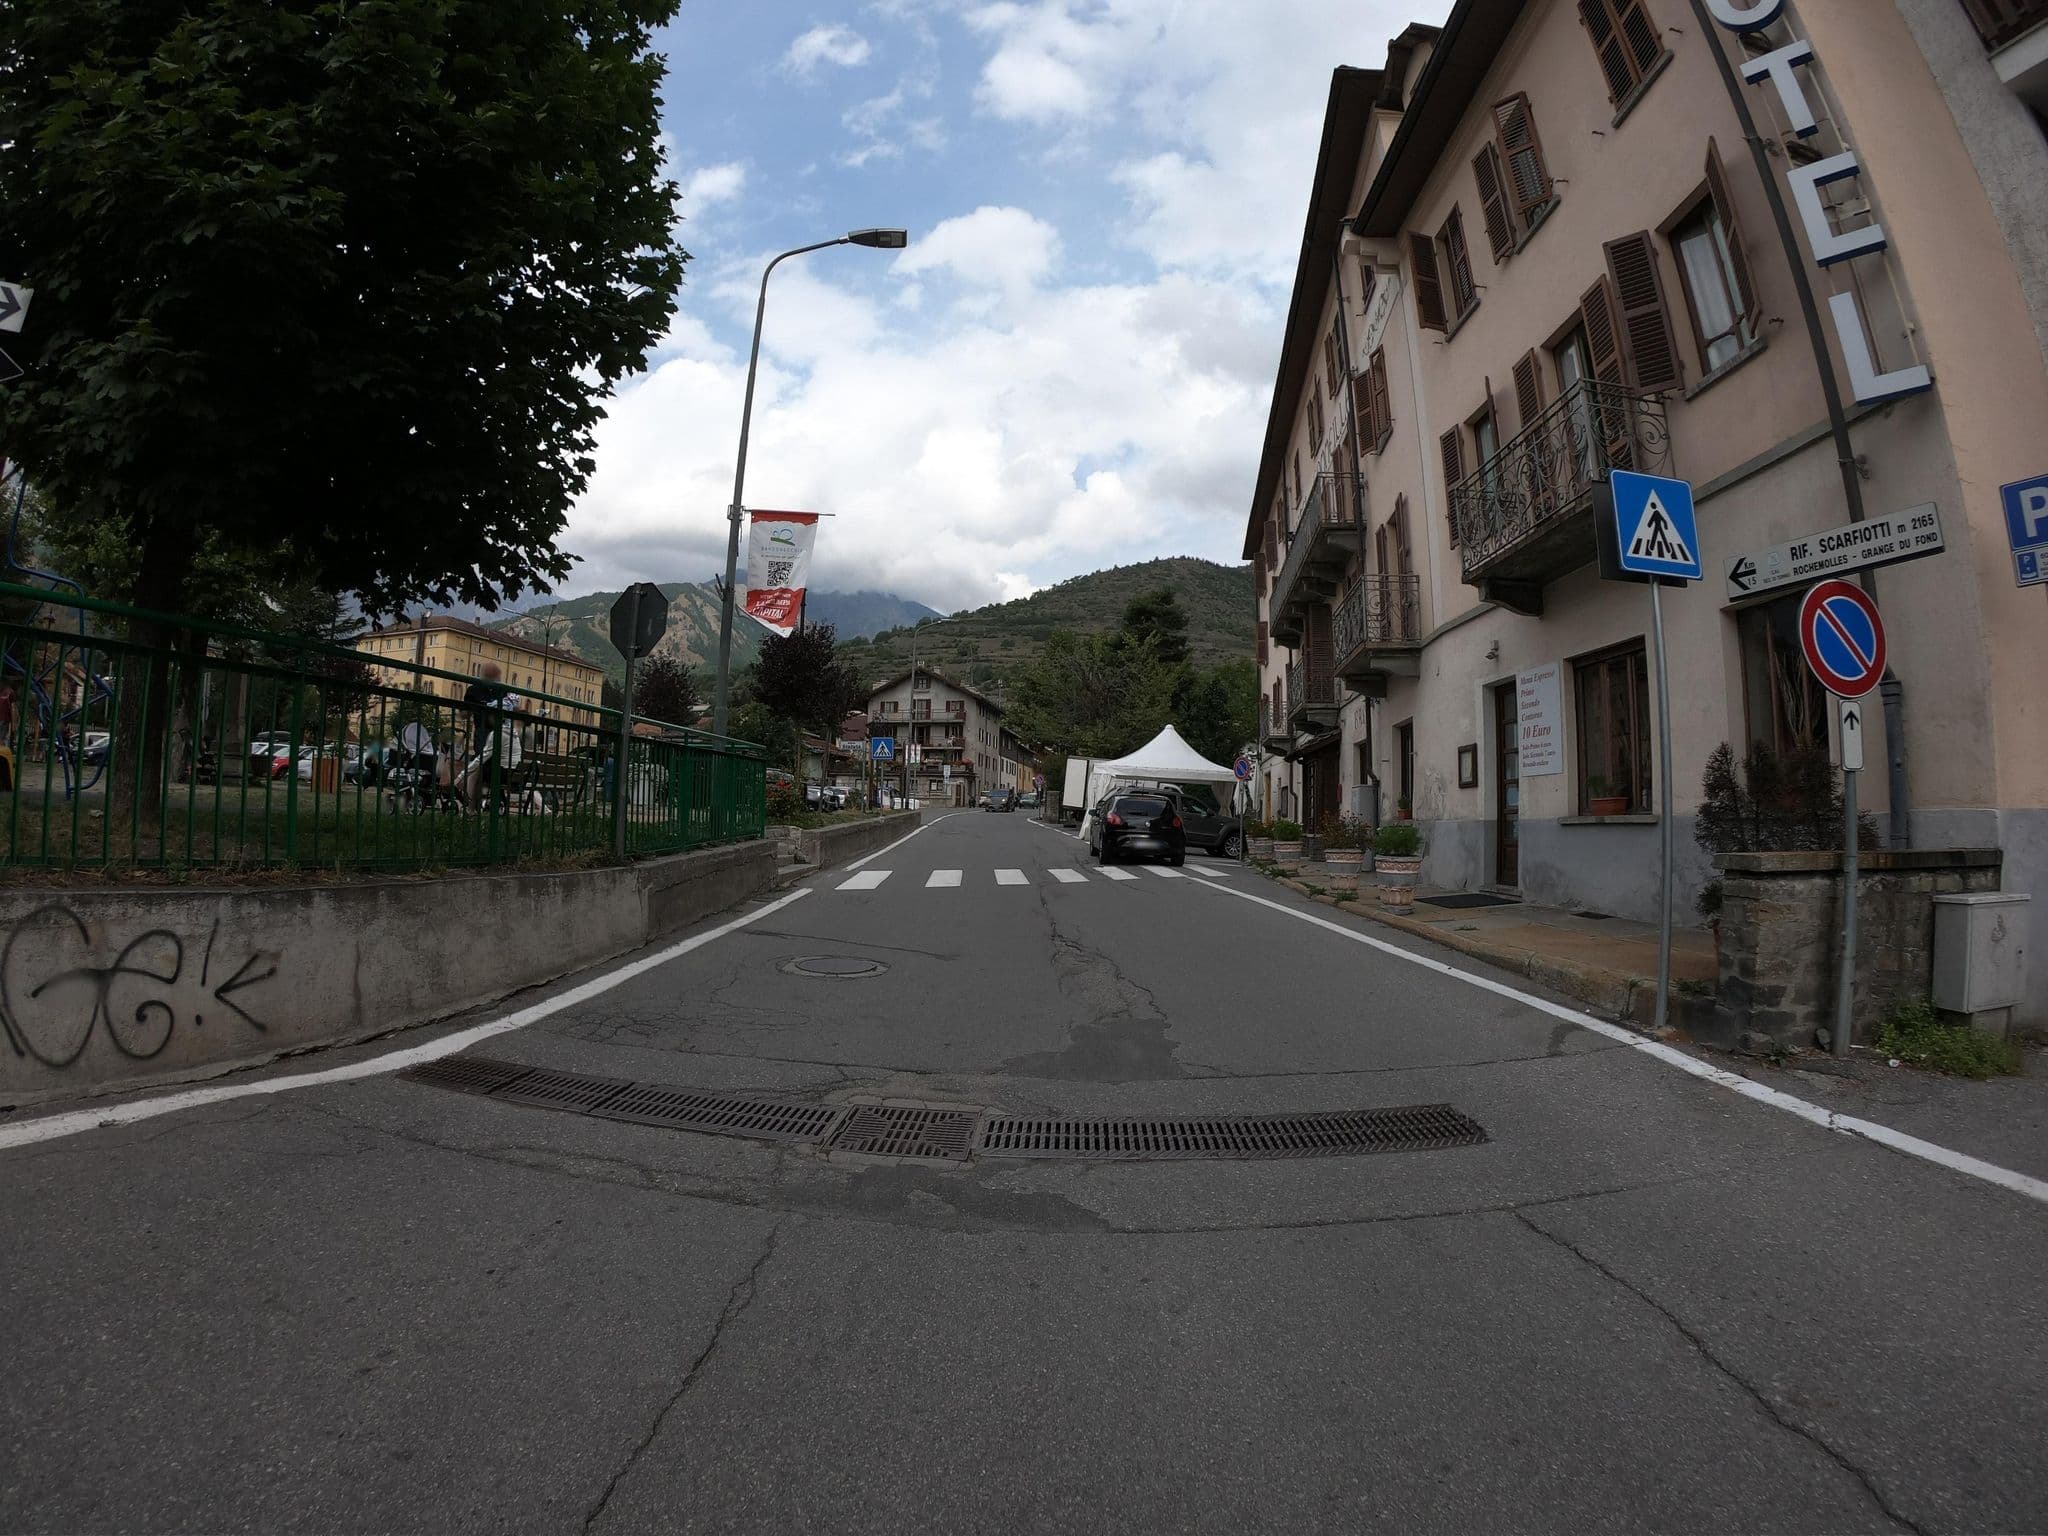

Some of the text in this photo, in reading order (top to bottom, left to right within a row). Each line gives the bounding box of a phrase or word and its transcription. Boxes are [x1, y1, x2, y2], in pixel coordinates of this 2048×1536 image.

[2018, 486, 2048, 538] P
[1790, 513, 1934, 561] RIF. SCARFIOTTI m 2165
[1744, 561, 1756, 570] Km
[1793, 551, 1849, 576] ROCHEMOLLES
[1861, 542, 1895, 559] GRANGE
[1900, 538, 1911, 549] DU
[1915, 532, 1938, 546] FOND
[1747, 577, 1757, 586] 15
[1522, 724, 1551, 740] 10 Euro
